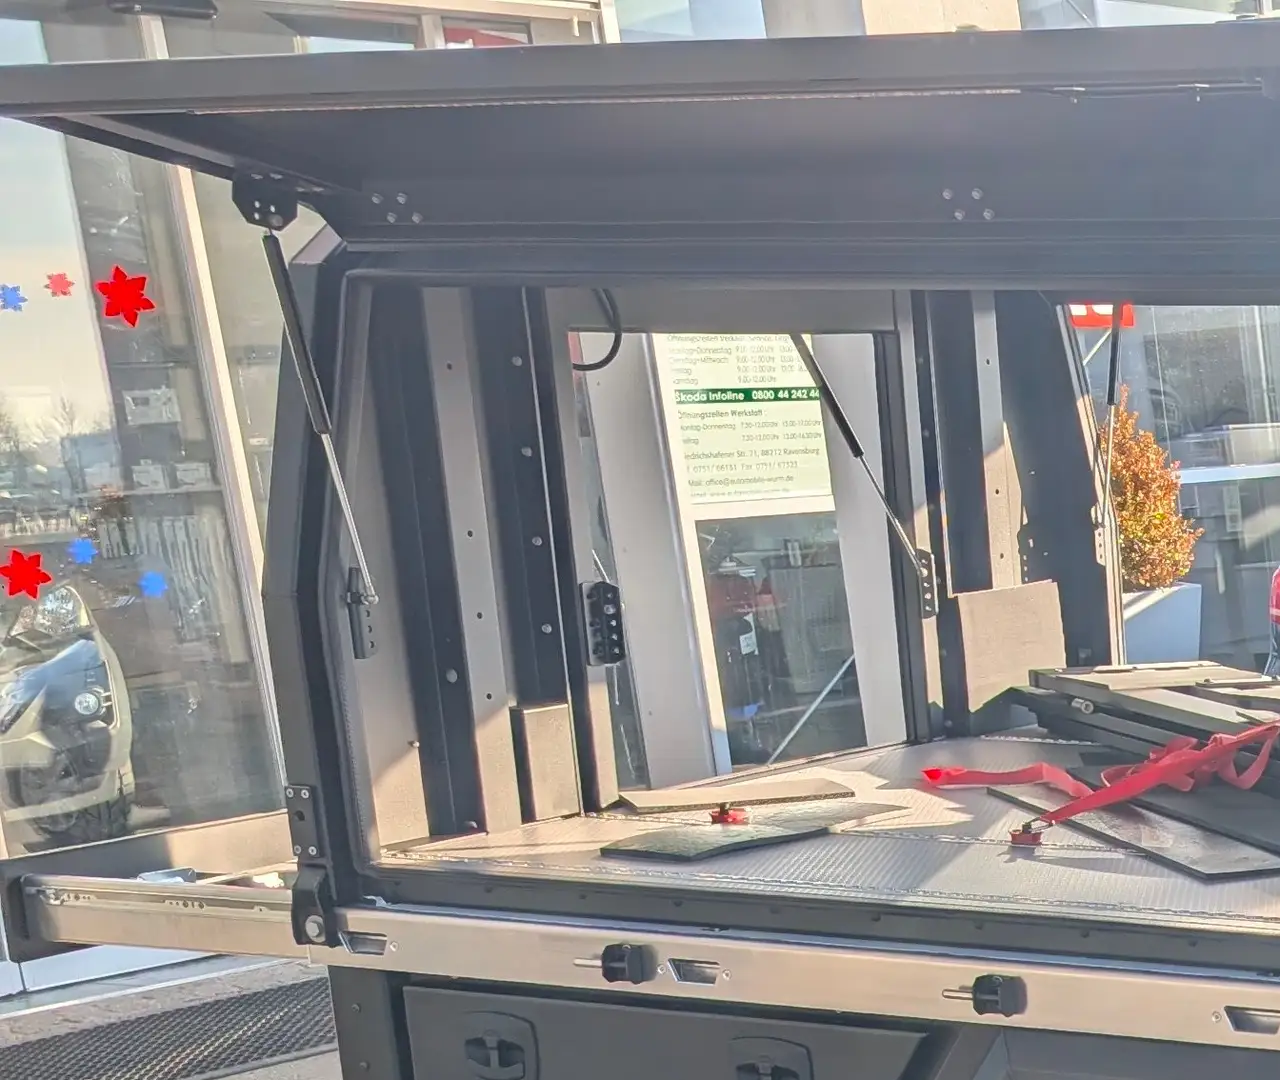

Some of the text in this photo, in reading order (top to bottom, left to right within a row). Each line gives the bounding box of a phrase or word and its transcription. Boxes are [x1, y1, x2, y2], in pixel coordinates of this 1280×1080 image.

[709, 390, 745, 401] Infoline
[752, 389, 775, 400] 0800
[778, 389, 789, 399] 44
[791, 389, 808, 399] 242
